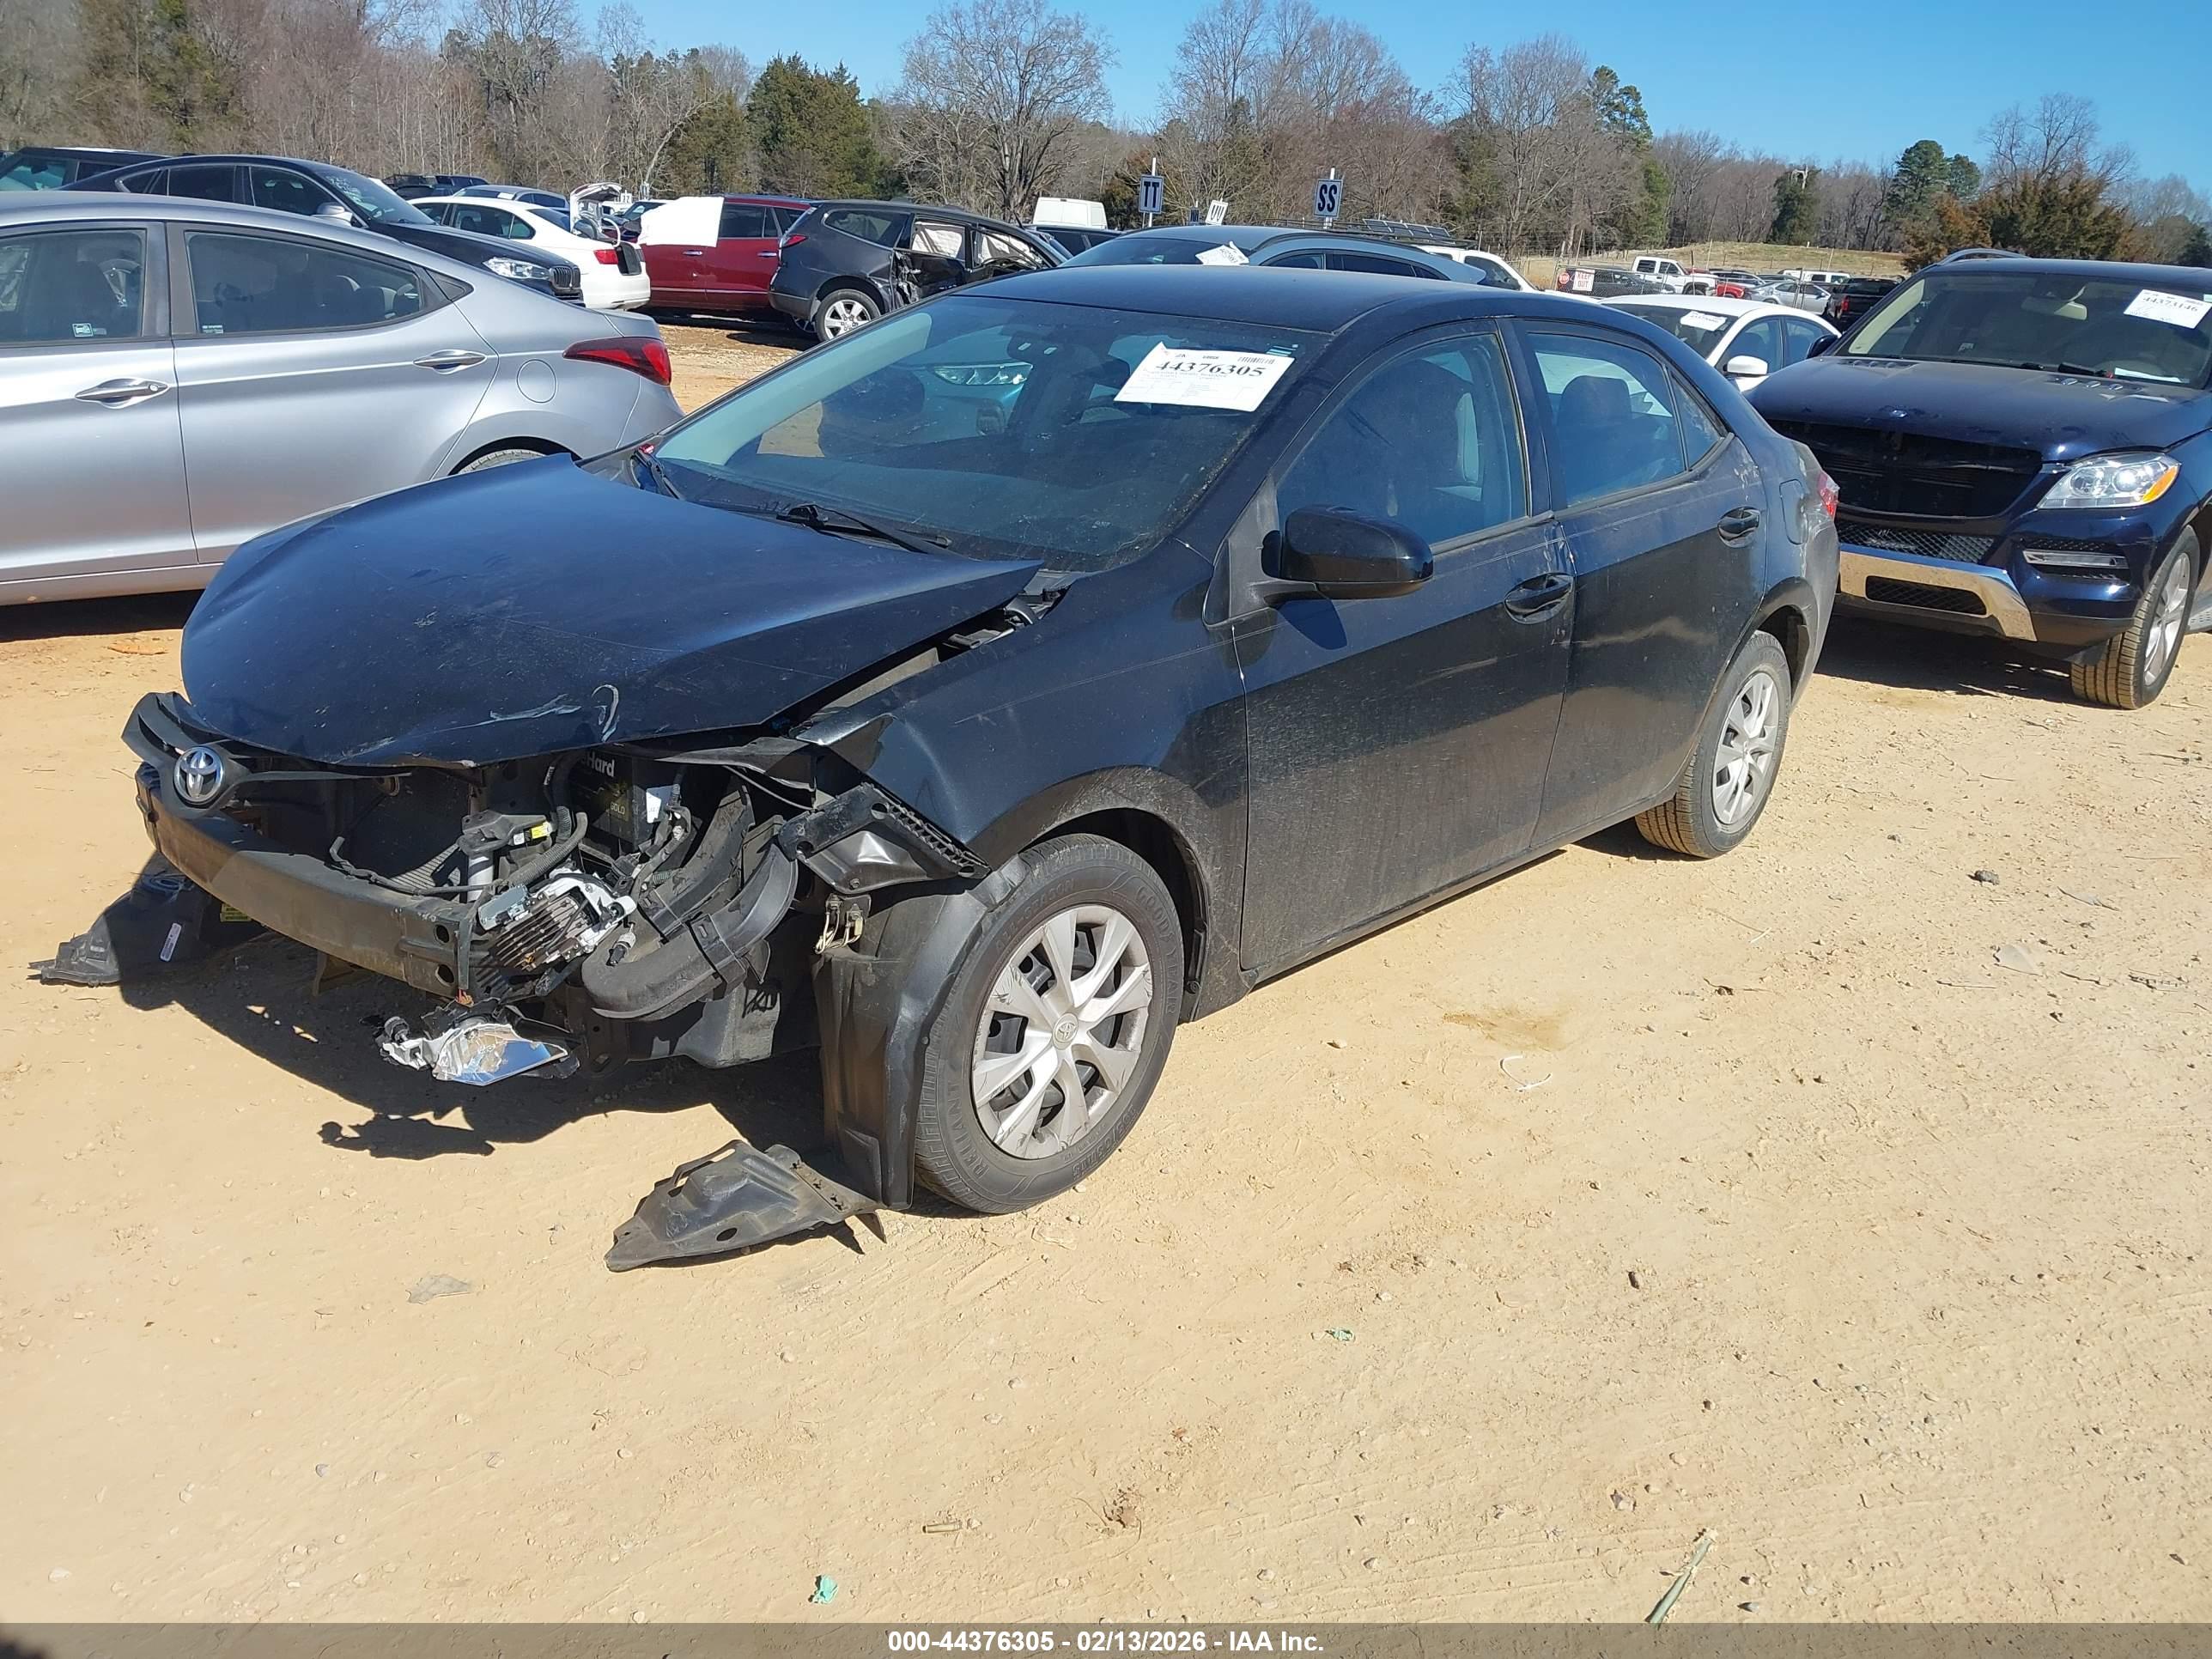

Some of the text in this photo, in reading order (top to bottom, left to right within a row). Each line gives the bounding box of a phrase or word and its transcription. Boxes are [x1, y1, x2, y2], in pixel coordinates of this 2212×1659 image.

[1143, 181, 1159, 208] TT
[1318, 185, 1337, 213] SS
[1156, 361, 1267, 377] 44376305
[610, 801, 625, 815] GOLD
